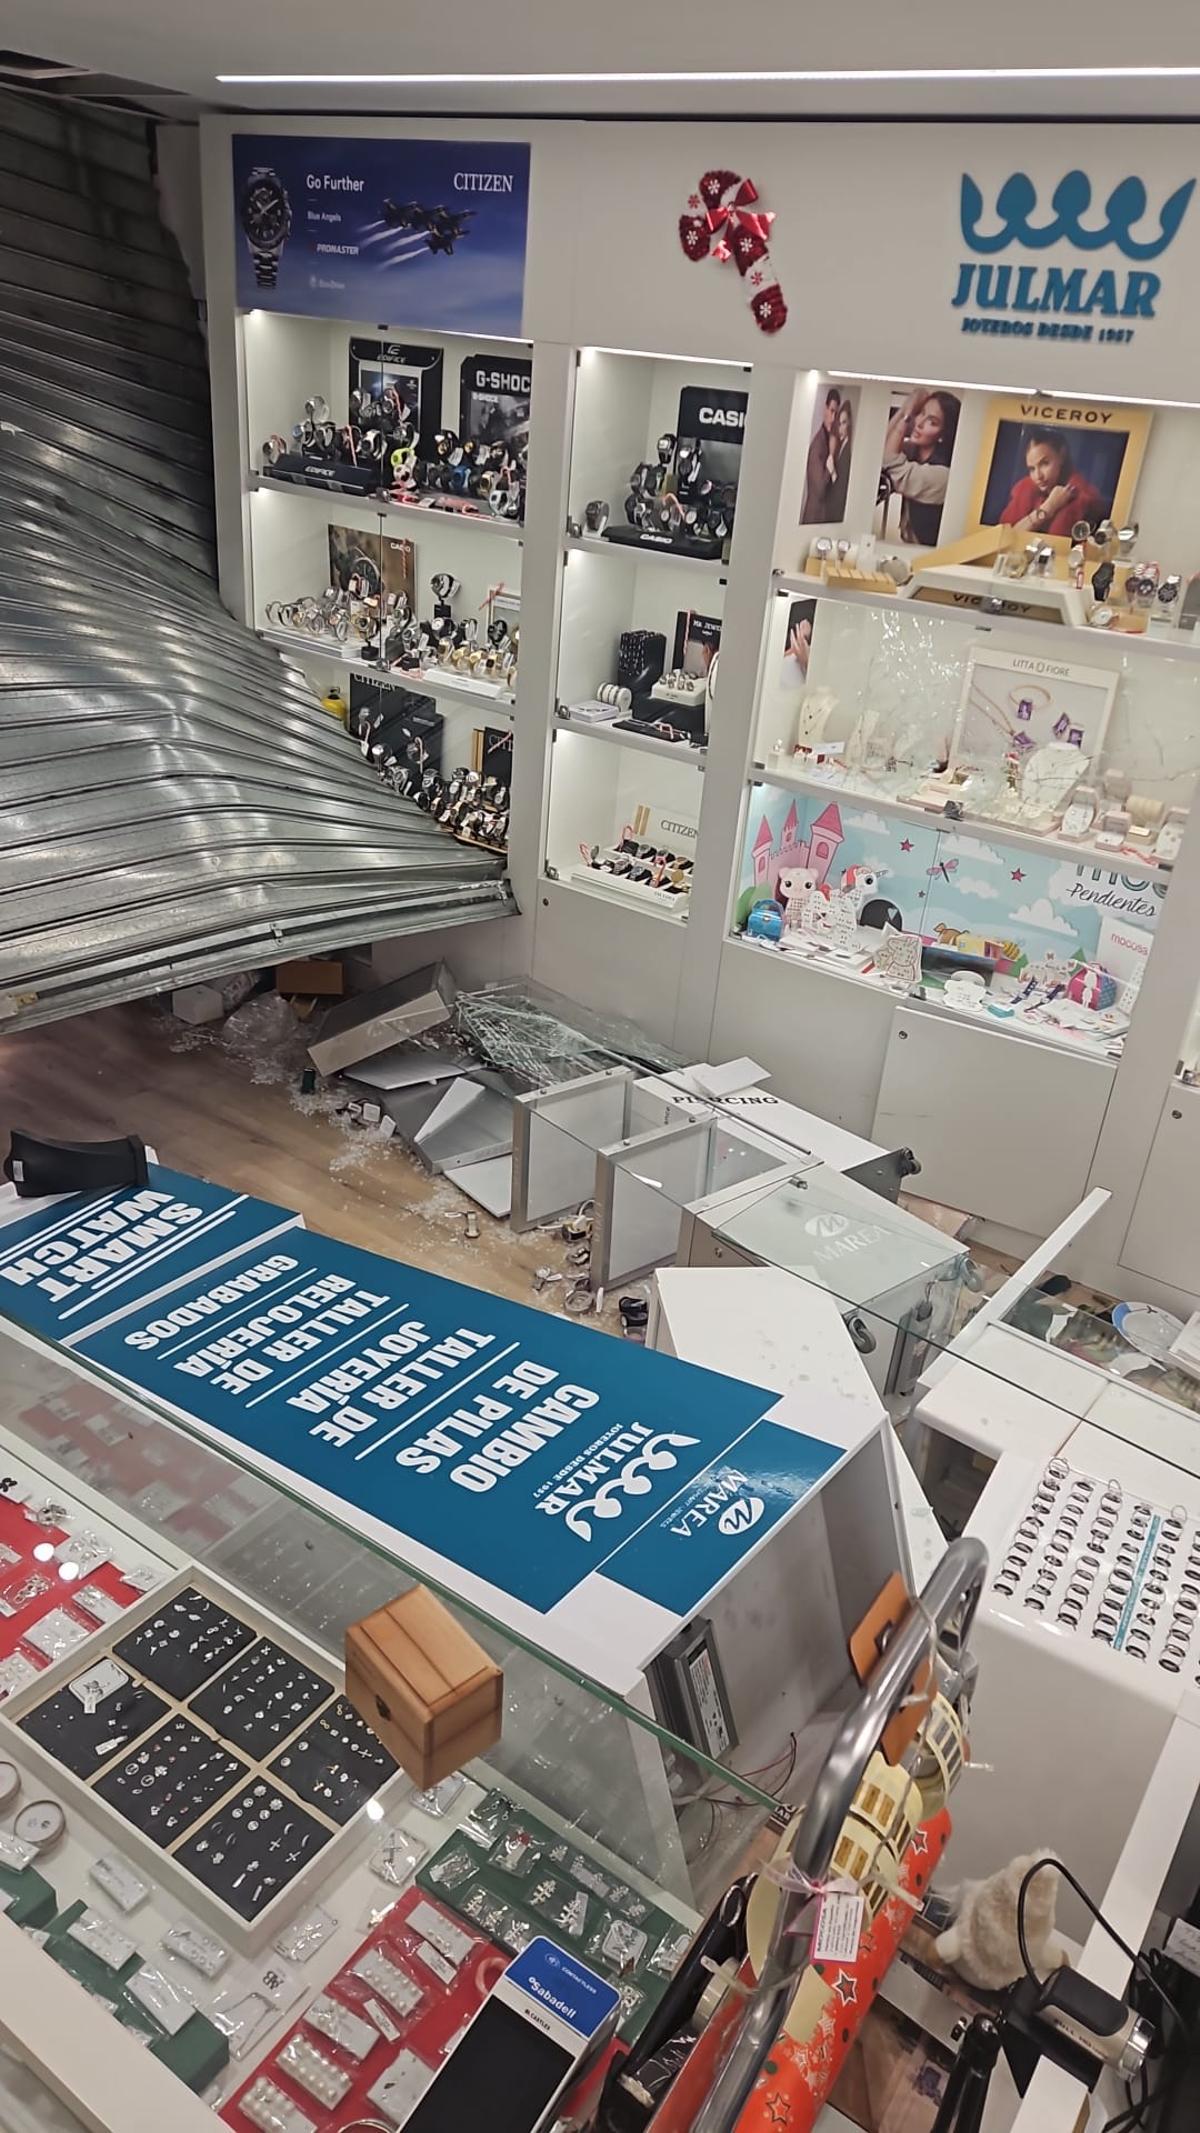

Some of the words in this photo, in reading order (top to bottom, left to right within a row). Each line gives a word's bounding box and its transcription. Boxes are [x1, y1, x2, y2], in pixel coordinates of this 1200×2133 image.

[306, 174, 321, 191] Go
[324, 175, 365, 193] Further
[453, 172, 513, 193] CITIZEN
[951, 263, 1161, 319] JULMAR
[1037, 321, 1094, 342] DESDE
[699, 407, 746, 428] CASI
[1020, 404, 1113, 425] VICEROY
[640, 533, 673, 544] CASIO
[1012, 659, 1034, 671] LITTA
[1066, 882, 1157, 917] Pendientes
[671, 1096, 779, 1105] PIRCING
[0, 1190, 175, 1286] WATCH
[36, 1202, 203, 1302] SMART
[124, 1255, 299, 1350] GRABADOS
[173, 1274, 357, 1377] RELOJERÍA
[262, 1290, 391, 1362] TALLER
[210, 1358, 274, 1395] DE
[286, 1321, 431, 1414] JOYERÍA
[361, 1328, 496, 1410] TALLER
[491, 1360, 560, 1400] DE
[309, 1406, 378, 1448] DE
[396, 1394, 513, 1474] PILAS
[450, 1384, 600, 1492] CAMBIO
[586, 1423, 623, 1457] JOYEROS
[535, 1422, 654, 1515] JULMAR
[553, 1455, 585, 1481] DESDE
[671, 1469, 748, 1536] MAREA
